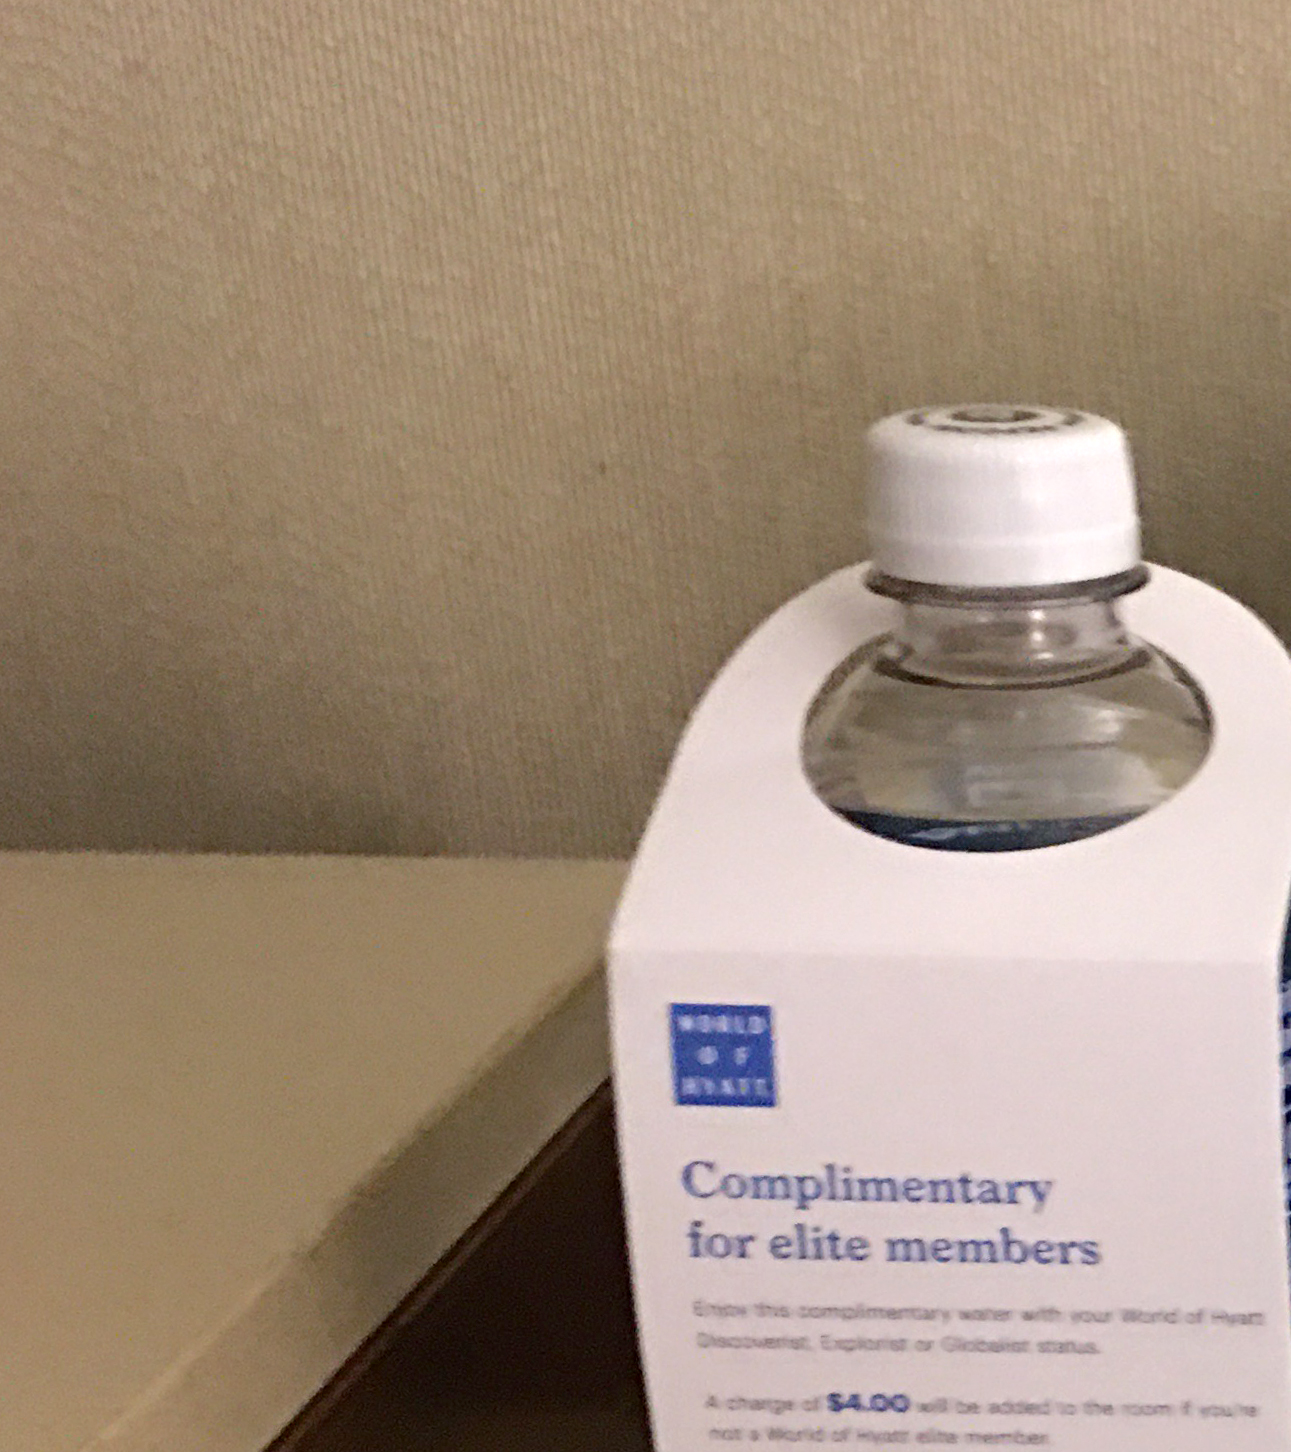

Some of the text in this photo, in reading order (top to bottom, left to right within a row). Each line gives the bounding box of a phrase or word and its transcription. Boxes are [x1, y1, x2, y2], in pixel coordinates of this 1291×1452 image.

[681, 1161, 1052, 1212] Complimentary
[687, 1220, 1102, 1265] for elite members
[826, 1392, 911, 1413] $4.00
